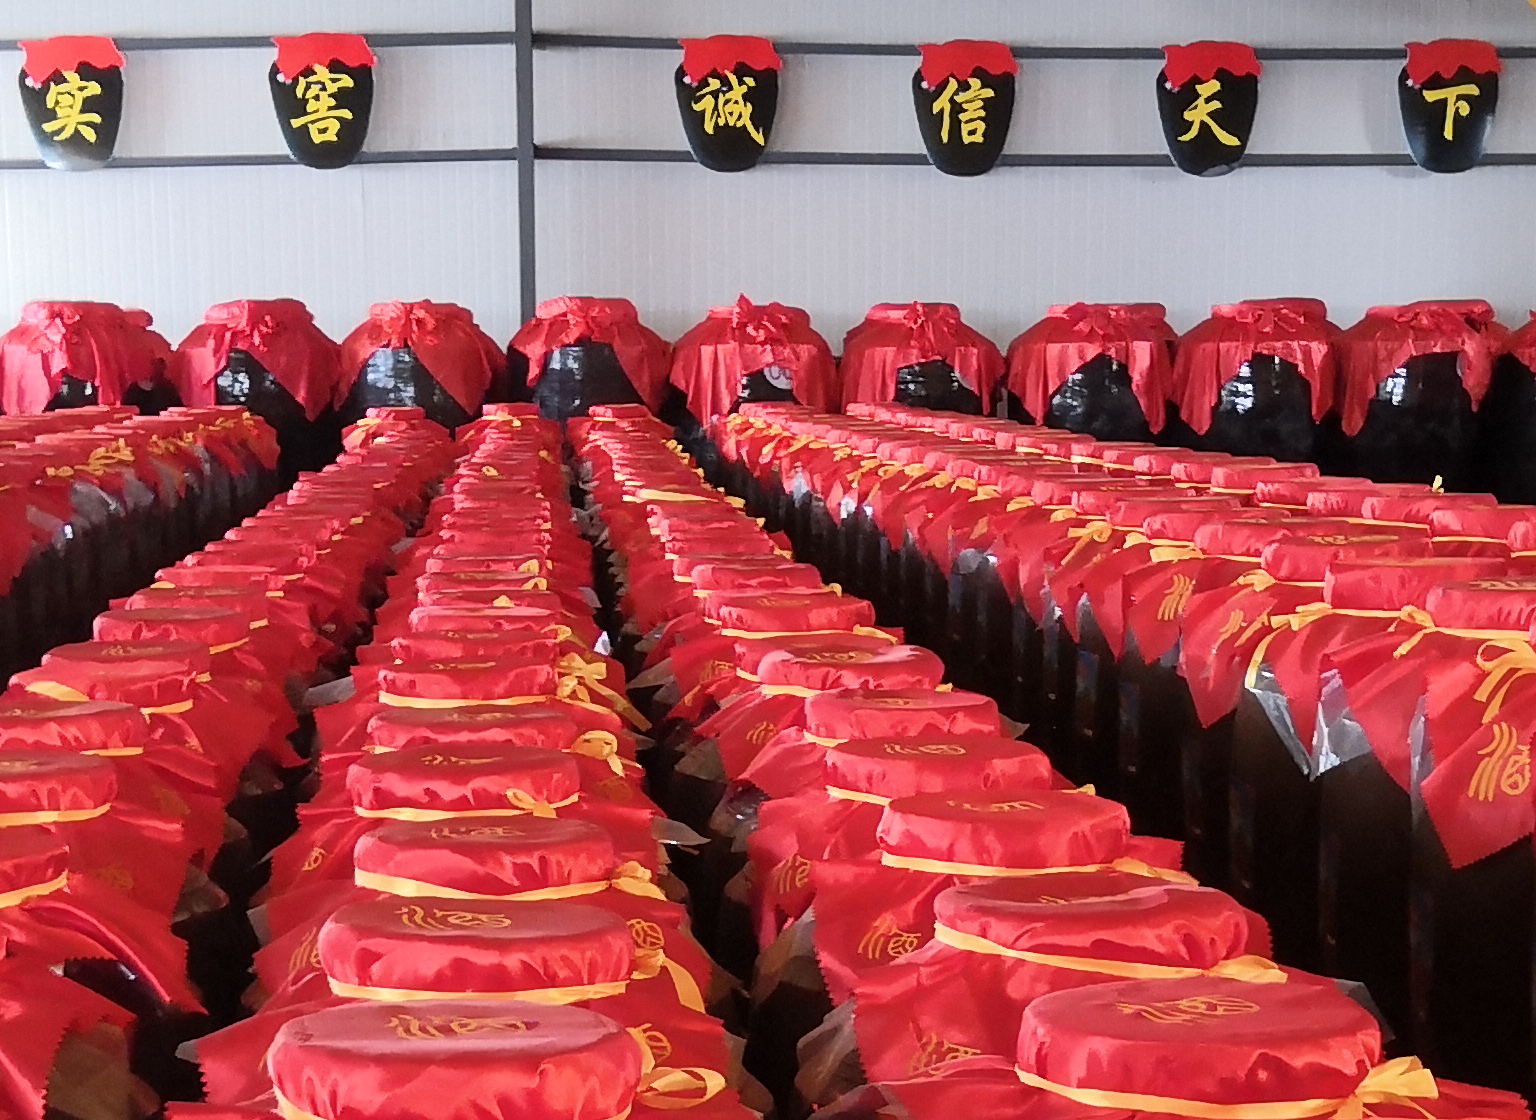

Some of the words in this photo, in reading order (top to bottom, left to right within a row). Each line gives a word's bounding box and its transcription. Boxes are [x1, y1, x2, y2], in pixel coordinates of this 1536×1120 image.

[44, 72, 101, 142] 实
[292, 66, 354, 143] 窖
[694, 73, 764, 144] 诚
[932, 78, 989, 147] 信
[1180, 81, 1240, 146] 天
[1424, 85, 1479, 139] 下
[1469, 722, 1531, 802] 酒
